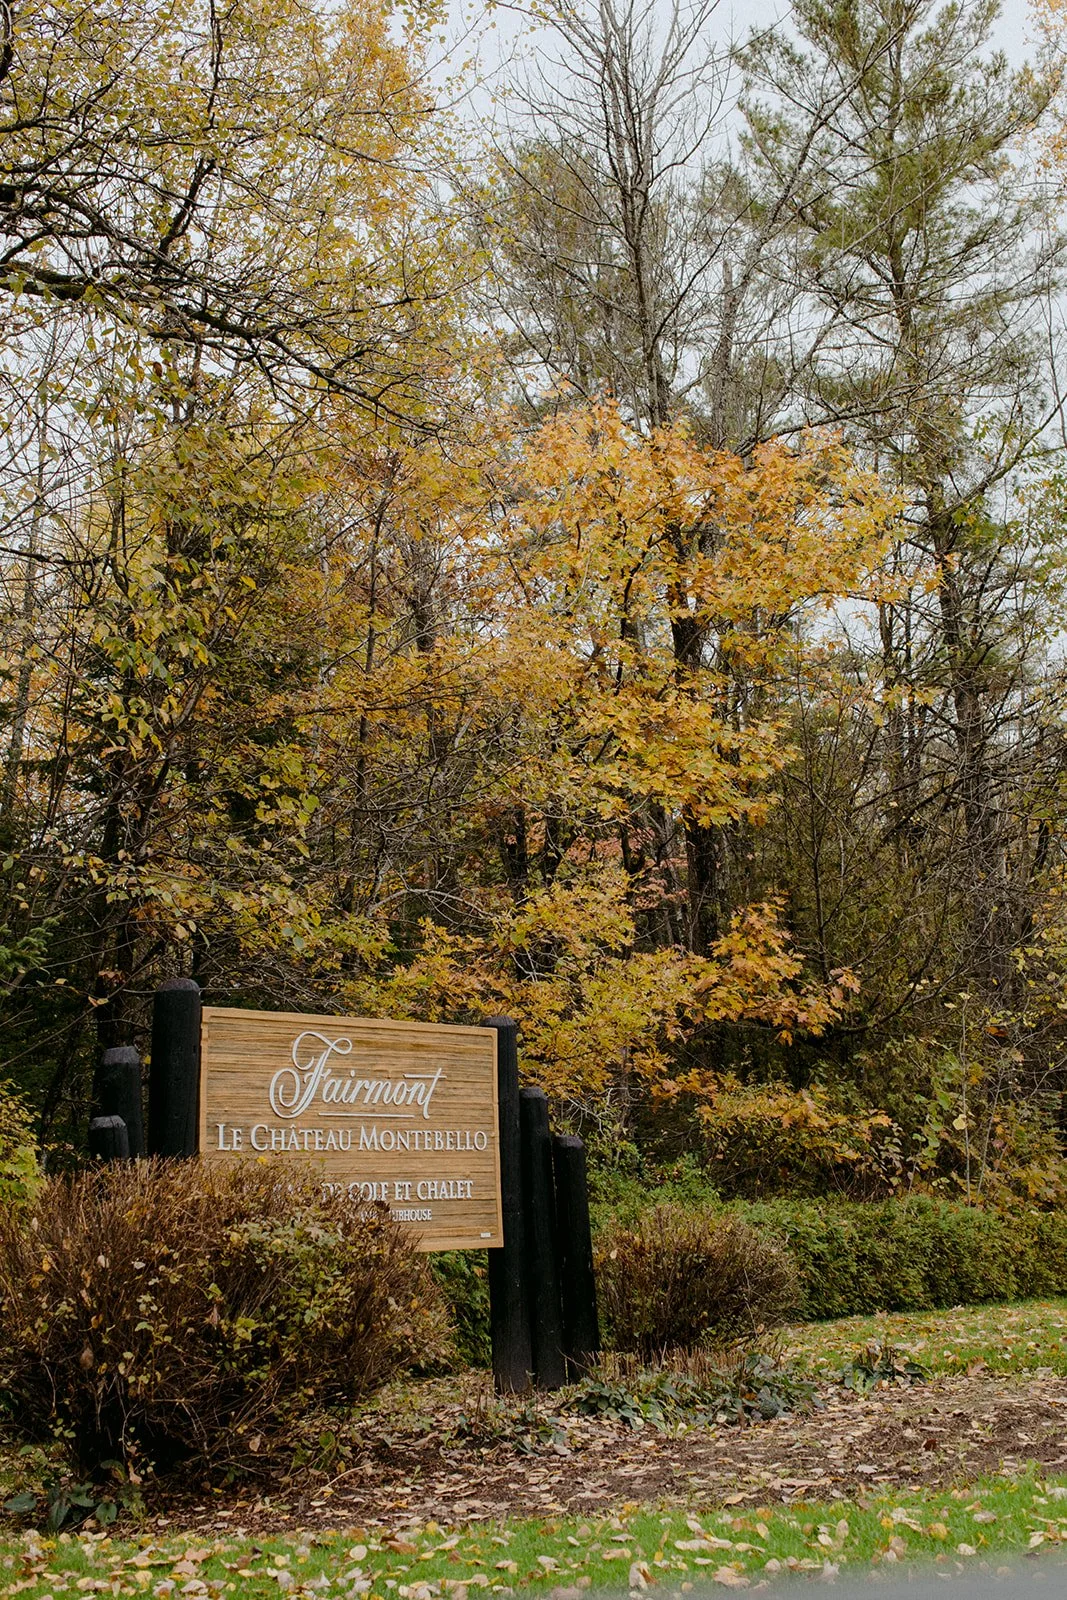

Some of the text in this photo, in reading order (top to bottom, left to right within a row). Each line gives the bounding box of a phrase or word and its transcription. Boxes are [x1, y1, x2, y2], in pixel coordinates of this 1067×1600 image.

[269, 1031, 448, 1120] Fairmont
[216, 1123, 488, 1152] LE CHÂTEAU MONTEBELLO
[394, 1181, 413, 1201] ET
[416, 1180, 474, 1200] CHALET
[387, 1208, 433, 1221] UBHOUSE
